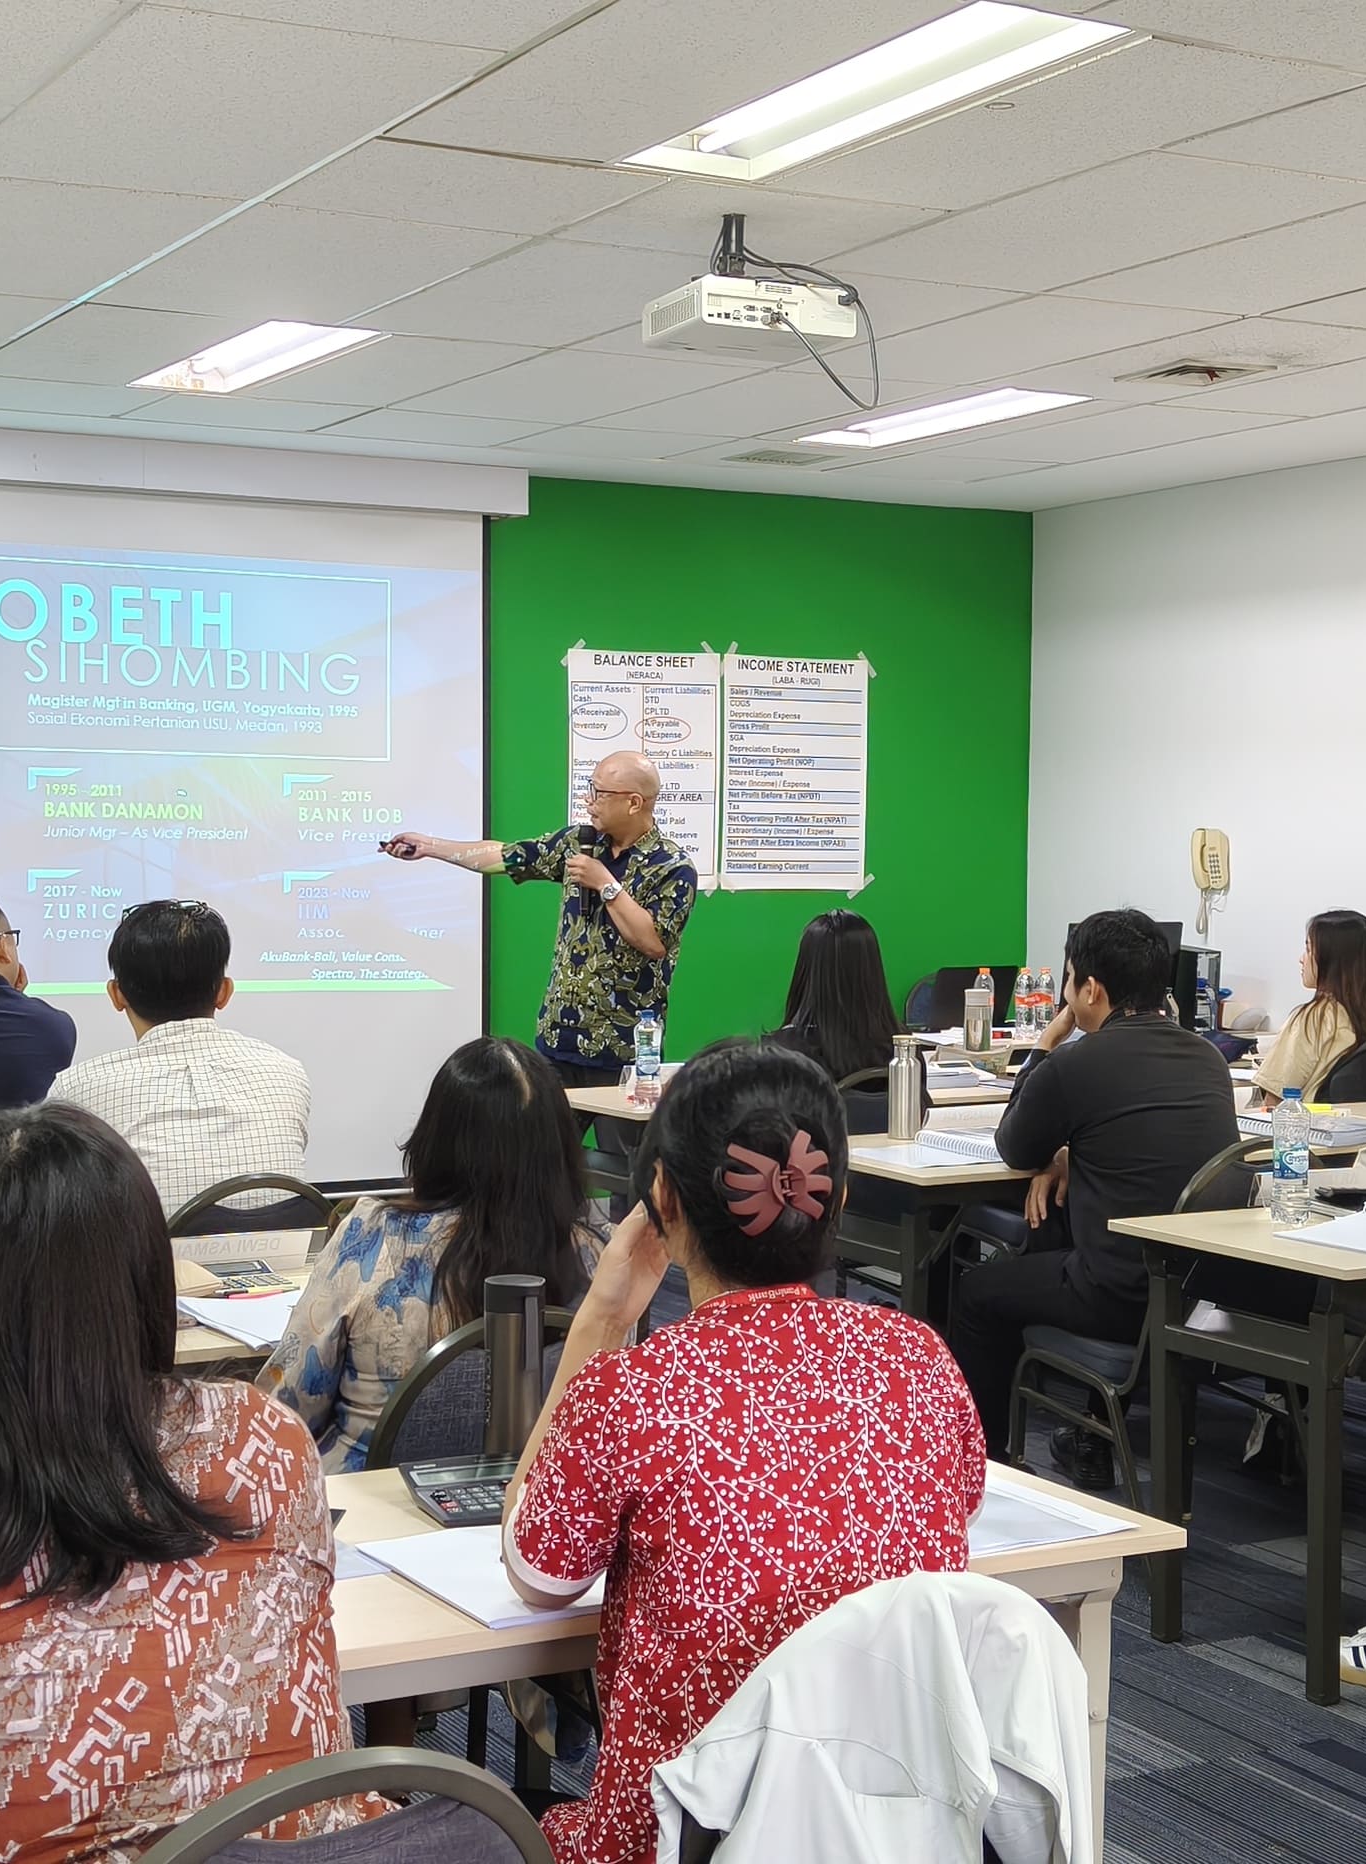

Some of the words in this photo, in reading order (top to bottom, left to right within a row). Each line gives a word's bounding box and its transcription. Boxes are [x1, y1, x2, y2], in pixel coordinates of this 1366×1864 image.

[23, 639, 360, 695] SIHOMBING
[594, 654, 652, 667] BALANCE
[656, 656, 695, 668] SHEET
[738, 659, 783, 672] INCOME
[786, 661, 854, 675] STATEMENT
[626, 671, 663, 681] (NERACA)
[772, 676, 794, 685] (LABA
[573, 684, 603, 693] Current
[604, 685, 631, 693] Assets
[644, 686, 674, 694] Current
[27, 693, 89, 709] Magister
[139, 697, 199, 714] Banking,
[202, 700, 239, 714] UGM,
[328, 704, 358, 718] 1995
[644, 696, 659, 704] STD
[644, 708, 669, 716] CPLTD
[27, 711, 67, 725] Sosial
[71, 712, 130, 727] Ekonomi
[134, 715, 199, 729] Pertanian
[293, 720, 322, 734] 1993
[44, 783, 76, 797] 1995
[90, 784, 122, 797] 2011
[298, 790, 327, 801] 2011
[341, 791, 372, 802] 2015
[44, 801, 95, 818] BANK
[102, 802, 203, 820] DANAMON
[298, 807, 352, 823] BANK
[363, 808, 403, 824] UOB
[43, 825, 85, 838] Junior
[89, 826, 116, 840] Mgr
[131, 827, 148, 839] As
[152, 826, 183, 839] Vice
[186, 826, 250, 840] President
[298, 828, 335, 841] Vice
[43, 885, 76, 897] 2017
[90, 885, 122, 897] Now
[298, 887, 329, 899] 2023
[341, 887, 370, 899] Now
[43, 903, 125, 920] ZURIC
[43, 927, 112, 945] Agency
[341, 951, 373, 962] Value
[360, 969, 380, 979] The
